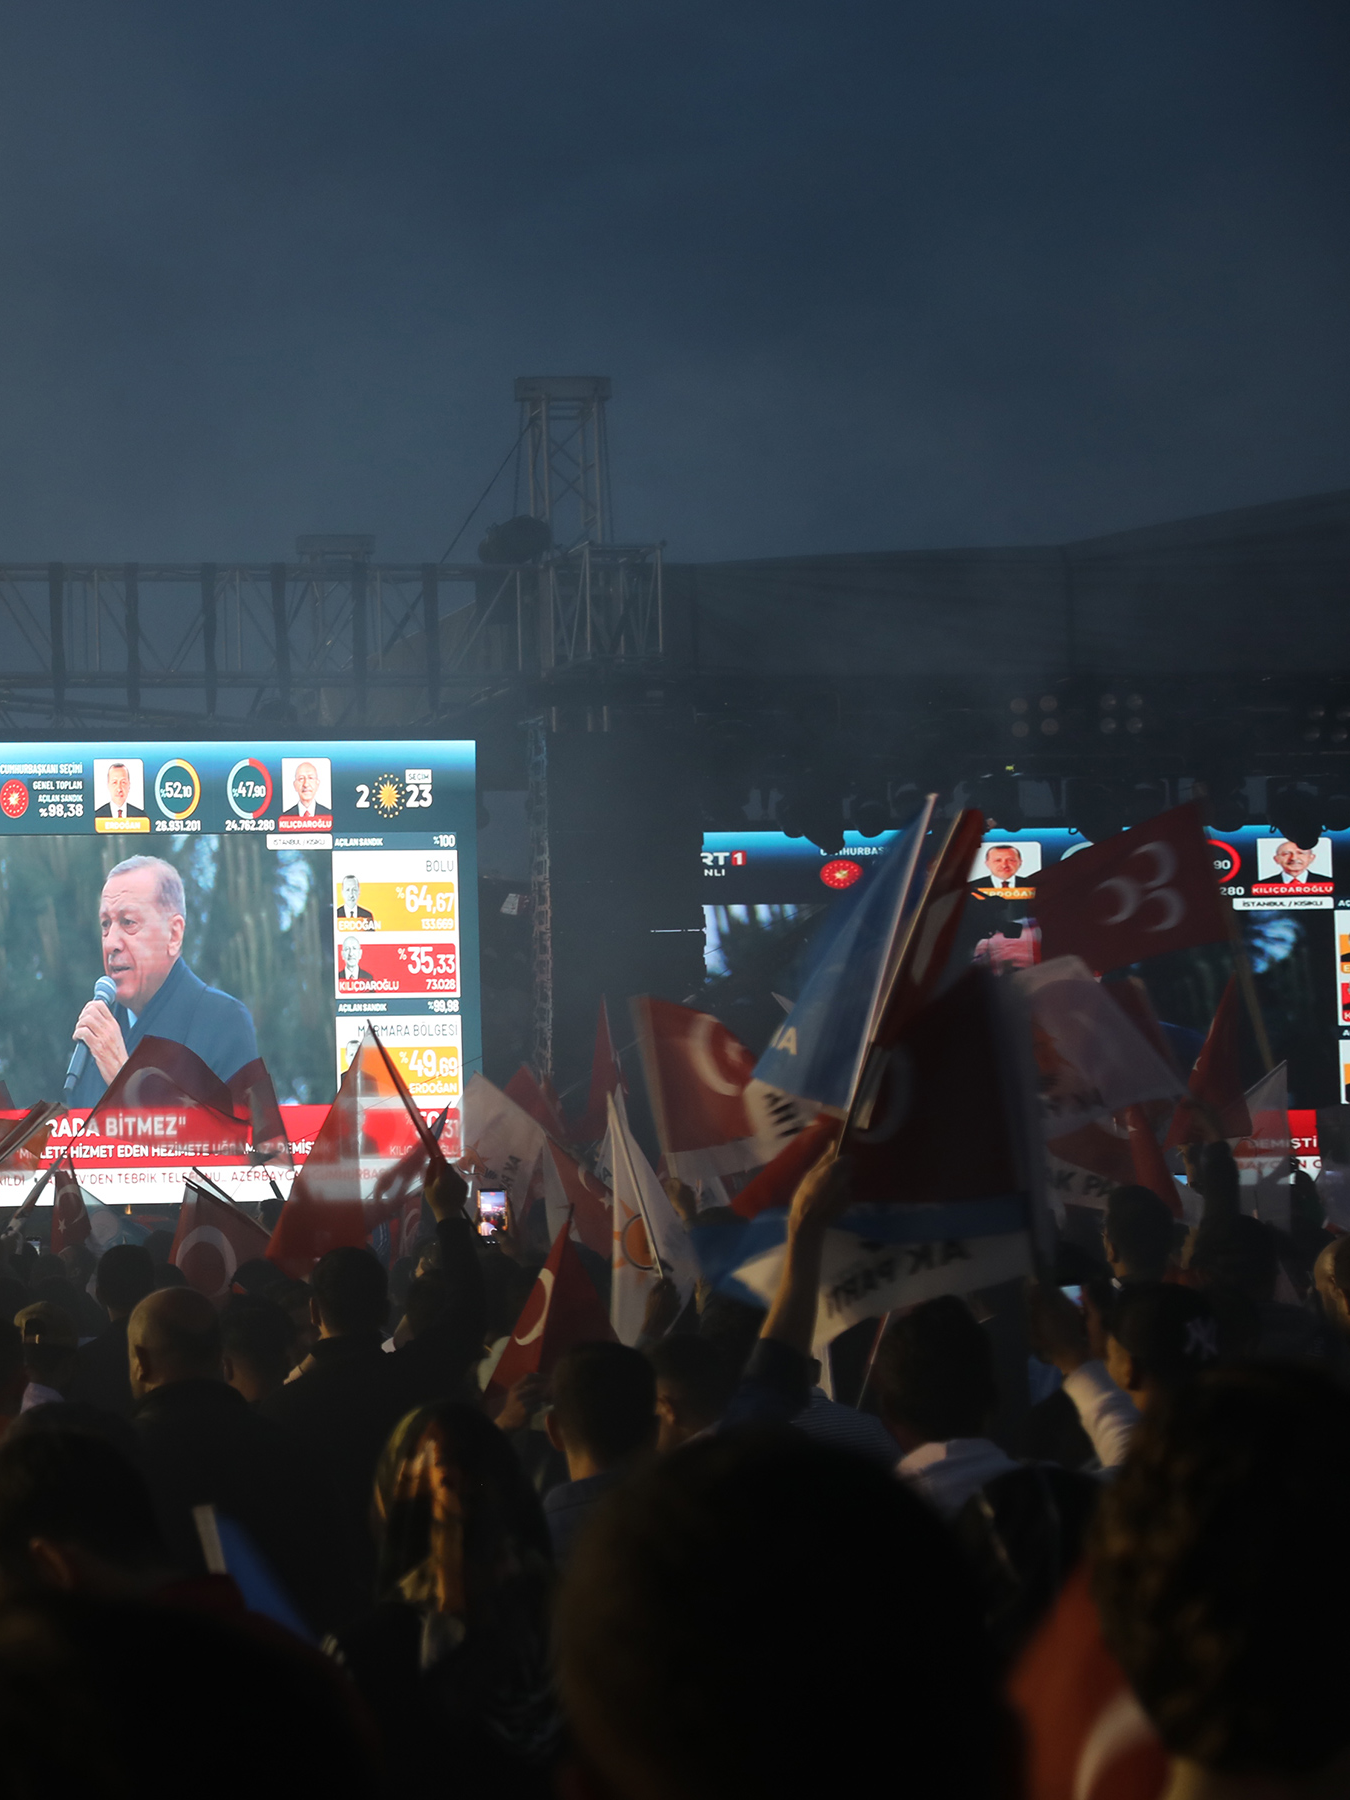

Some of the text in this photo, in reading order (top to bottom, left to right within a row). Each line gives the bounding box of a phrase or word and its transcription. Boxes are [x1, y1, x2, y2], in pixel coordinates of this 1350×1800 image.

[33, 780, 83, 790] GENEL TOPLAM
[61, 794, 83, 803] SANDIK
[39, 803, 84, 818] %98,38
[432, 834, 456, 848] %100
[425, 859, 454, 872] BOLU
[700, 851, 744, 866] RT1
[703, 868, 726, 877] NLI
[1252, 884, 1334, 895] KILIÇDAROĞLU
[396, 884, 455, 914] %64,67
[338, 918, 382, 930] ERDOĞAN
[397, 946, 456, 976] %35,33
[339, 978, 457, 992] KILIÇDAROĞLU 73.028
[399, 1049, 458, 1079] %49,69
[408, 1080, 458, 1094] ERDOĞAN
[70, 1142, 115, 1158] HİZMET
[117, 1144, 149, 1158] EDEN
